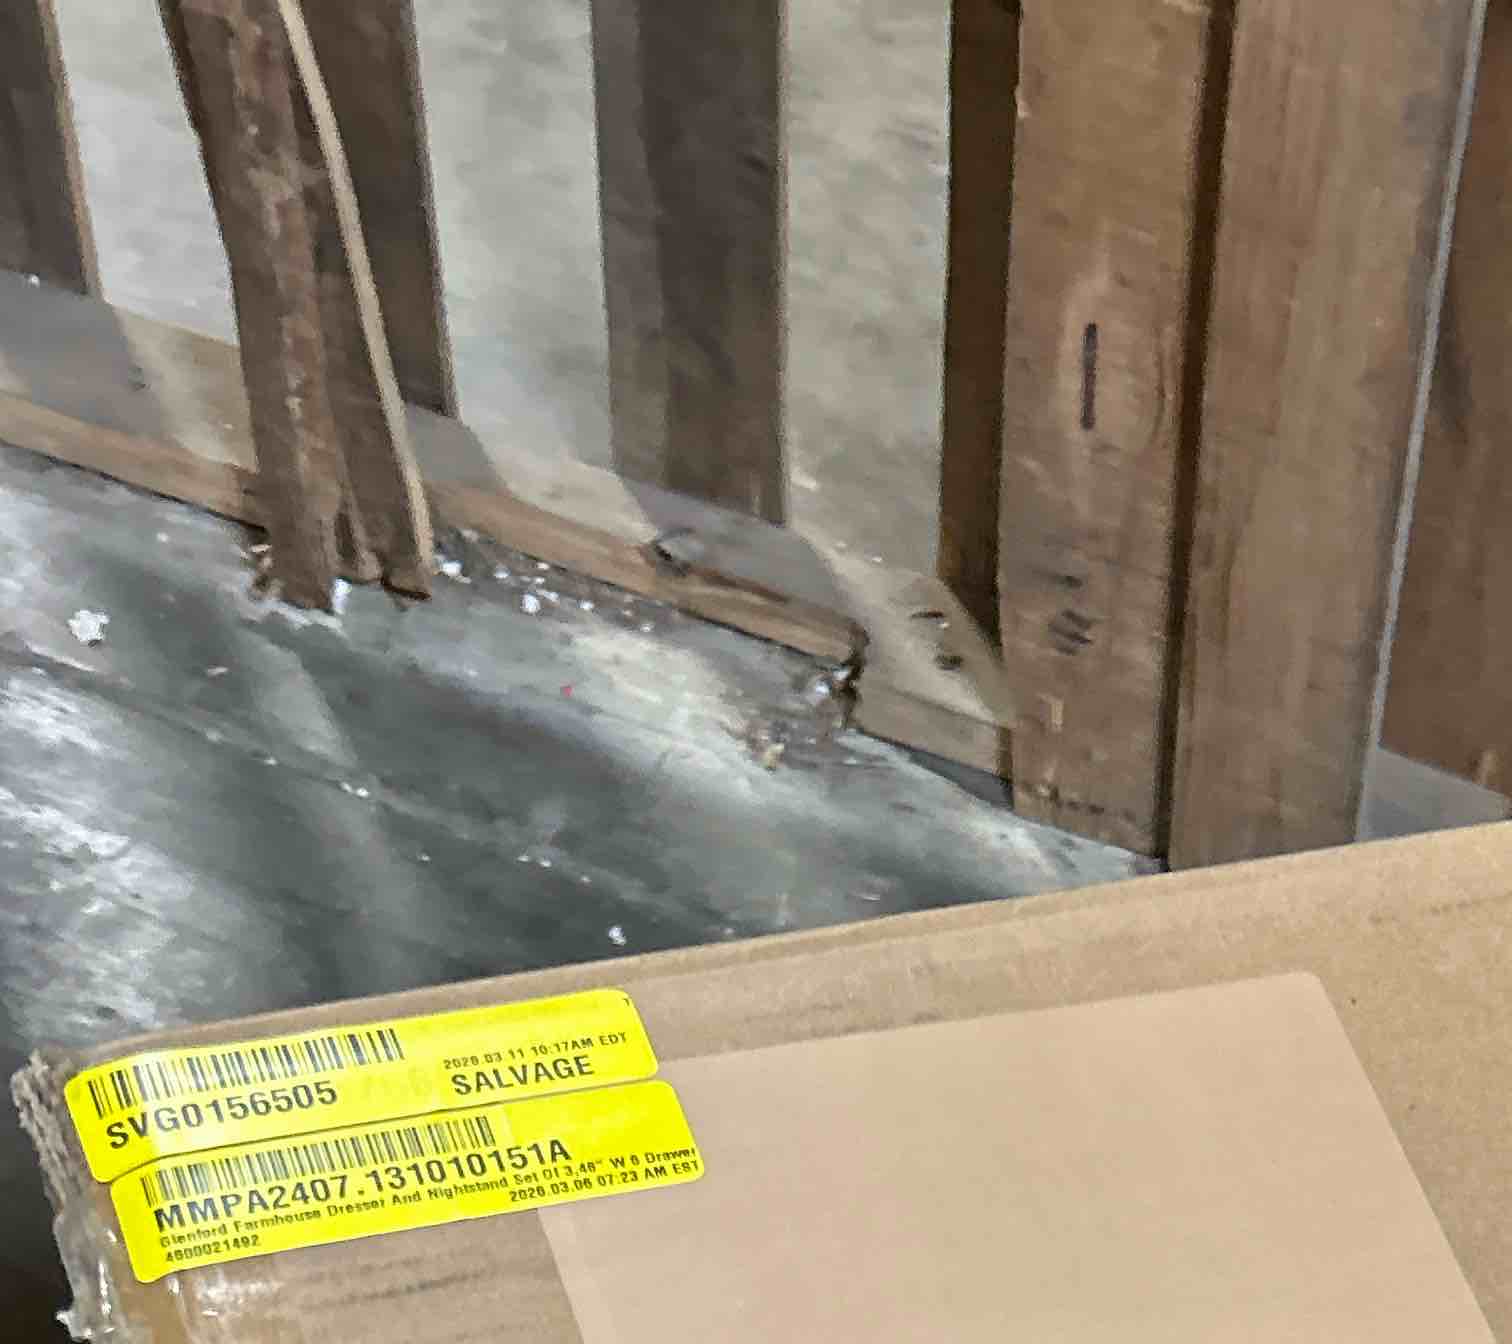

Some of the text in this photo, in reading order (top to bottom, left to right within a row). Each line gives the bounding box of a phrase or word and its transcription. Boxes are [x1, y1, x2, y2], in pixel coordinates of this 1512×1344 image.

[451, 1055, 595, 1095] SALVAGE
[106, 1080, 338, 1149] SVG0156505
[154, 1139, 572, 1232] MMPA2407.131010151A
[234, 1209, 321, 1233] Farmhouse
[327, 1199, 385, 1217] Dresser
[392, 1191, 420, 1206] And
[428, 1177, 509, 1200] Nightstand
[514, 1172, 537, 1186] Set
[609, 1157, 625, 1170] W
[644, 1165, 668, 1179] AM
[672, 1159, 699, 1175] EST
